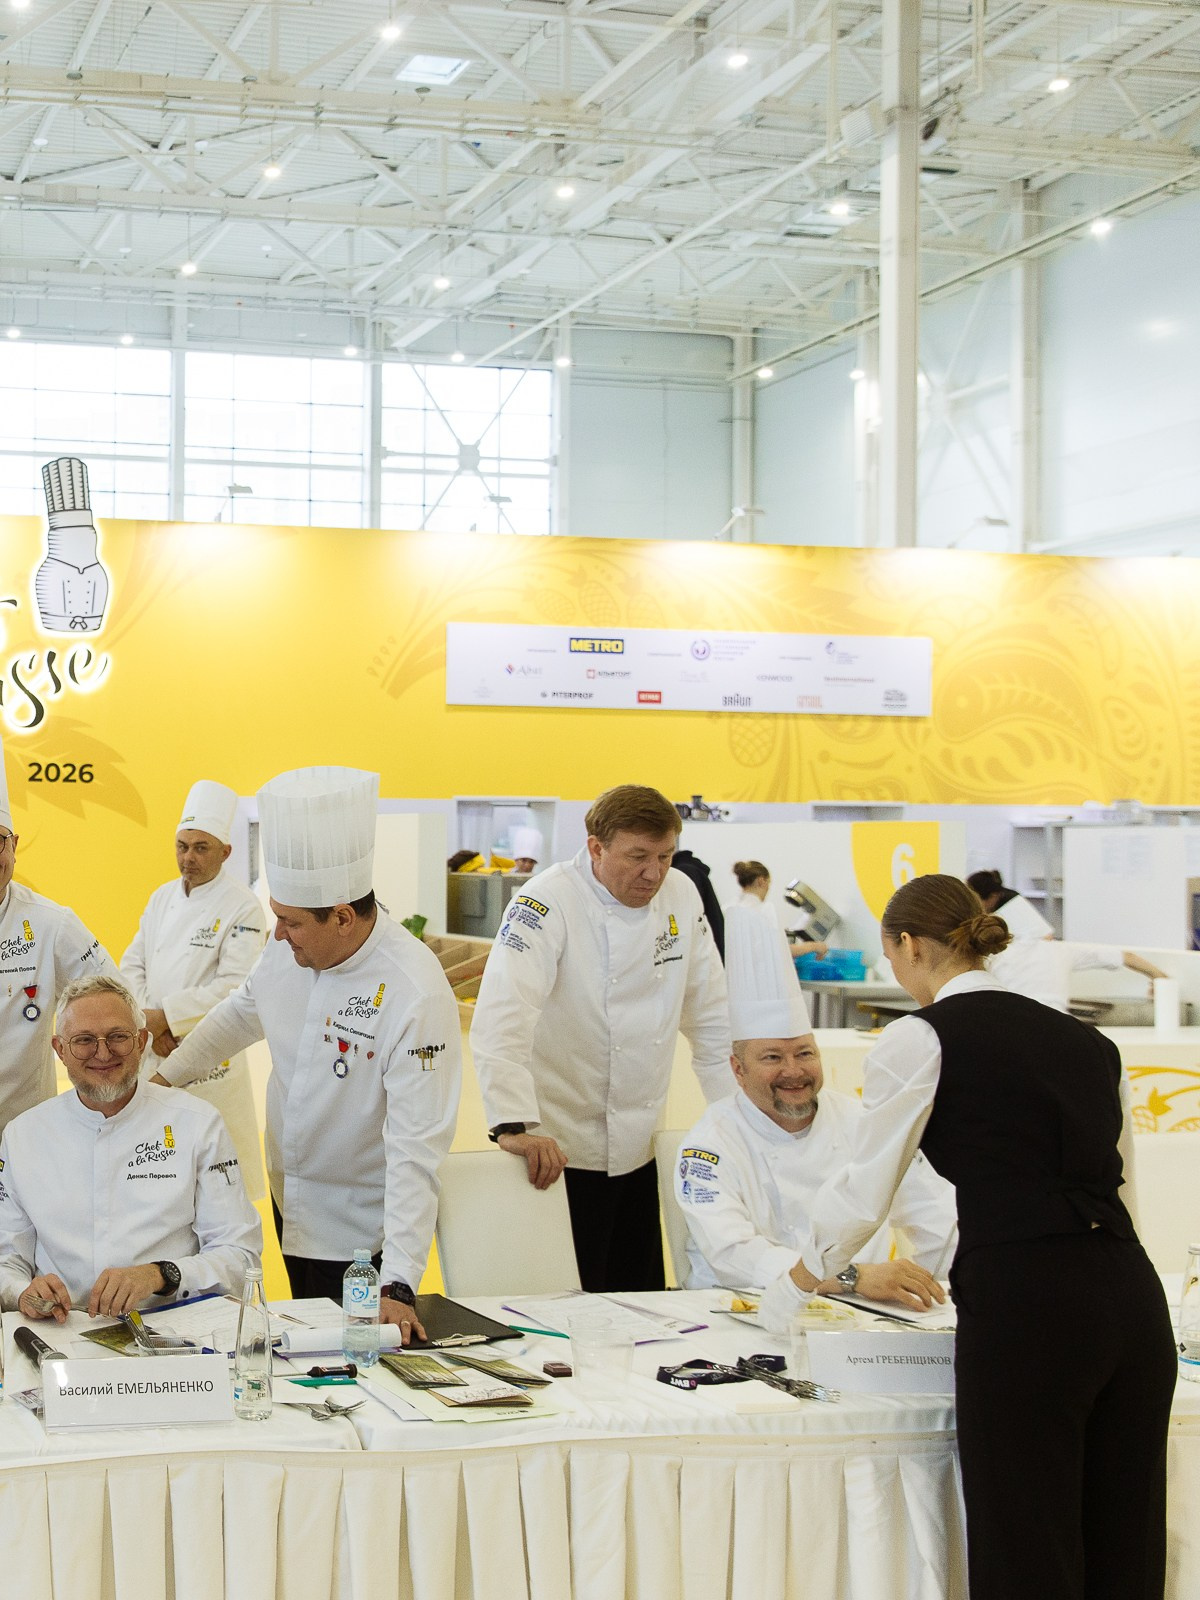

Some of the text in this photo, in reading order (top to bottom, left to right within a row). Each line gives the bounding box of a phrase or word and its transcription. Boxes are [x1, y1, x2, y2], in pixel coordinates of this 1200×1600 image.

[570, 639, 623, 653] METRO
[28, 763, 95, 784] 2026
[891, 843, 916, 891] 6
[846, 1355, 953, 1366] Артем ГРЕБЕНЩИКОВ
[59, 1380, 214, 1397] Василий ЕМЕЛЬЯНЕНКО
